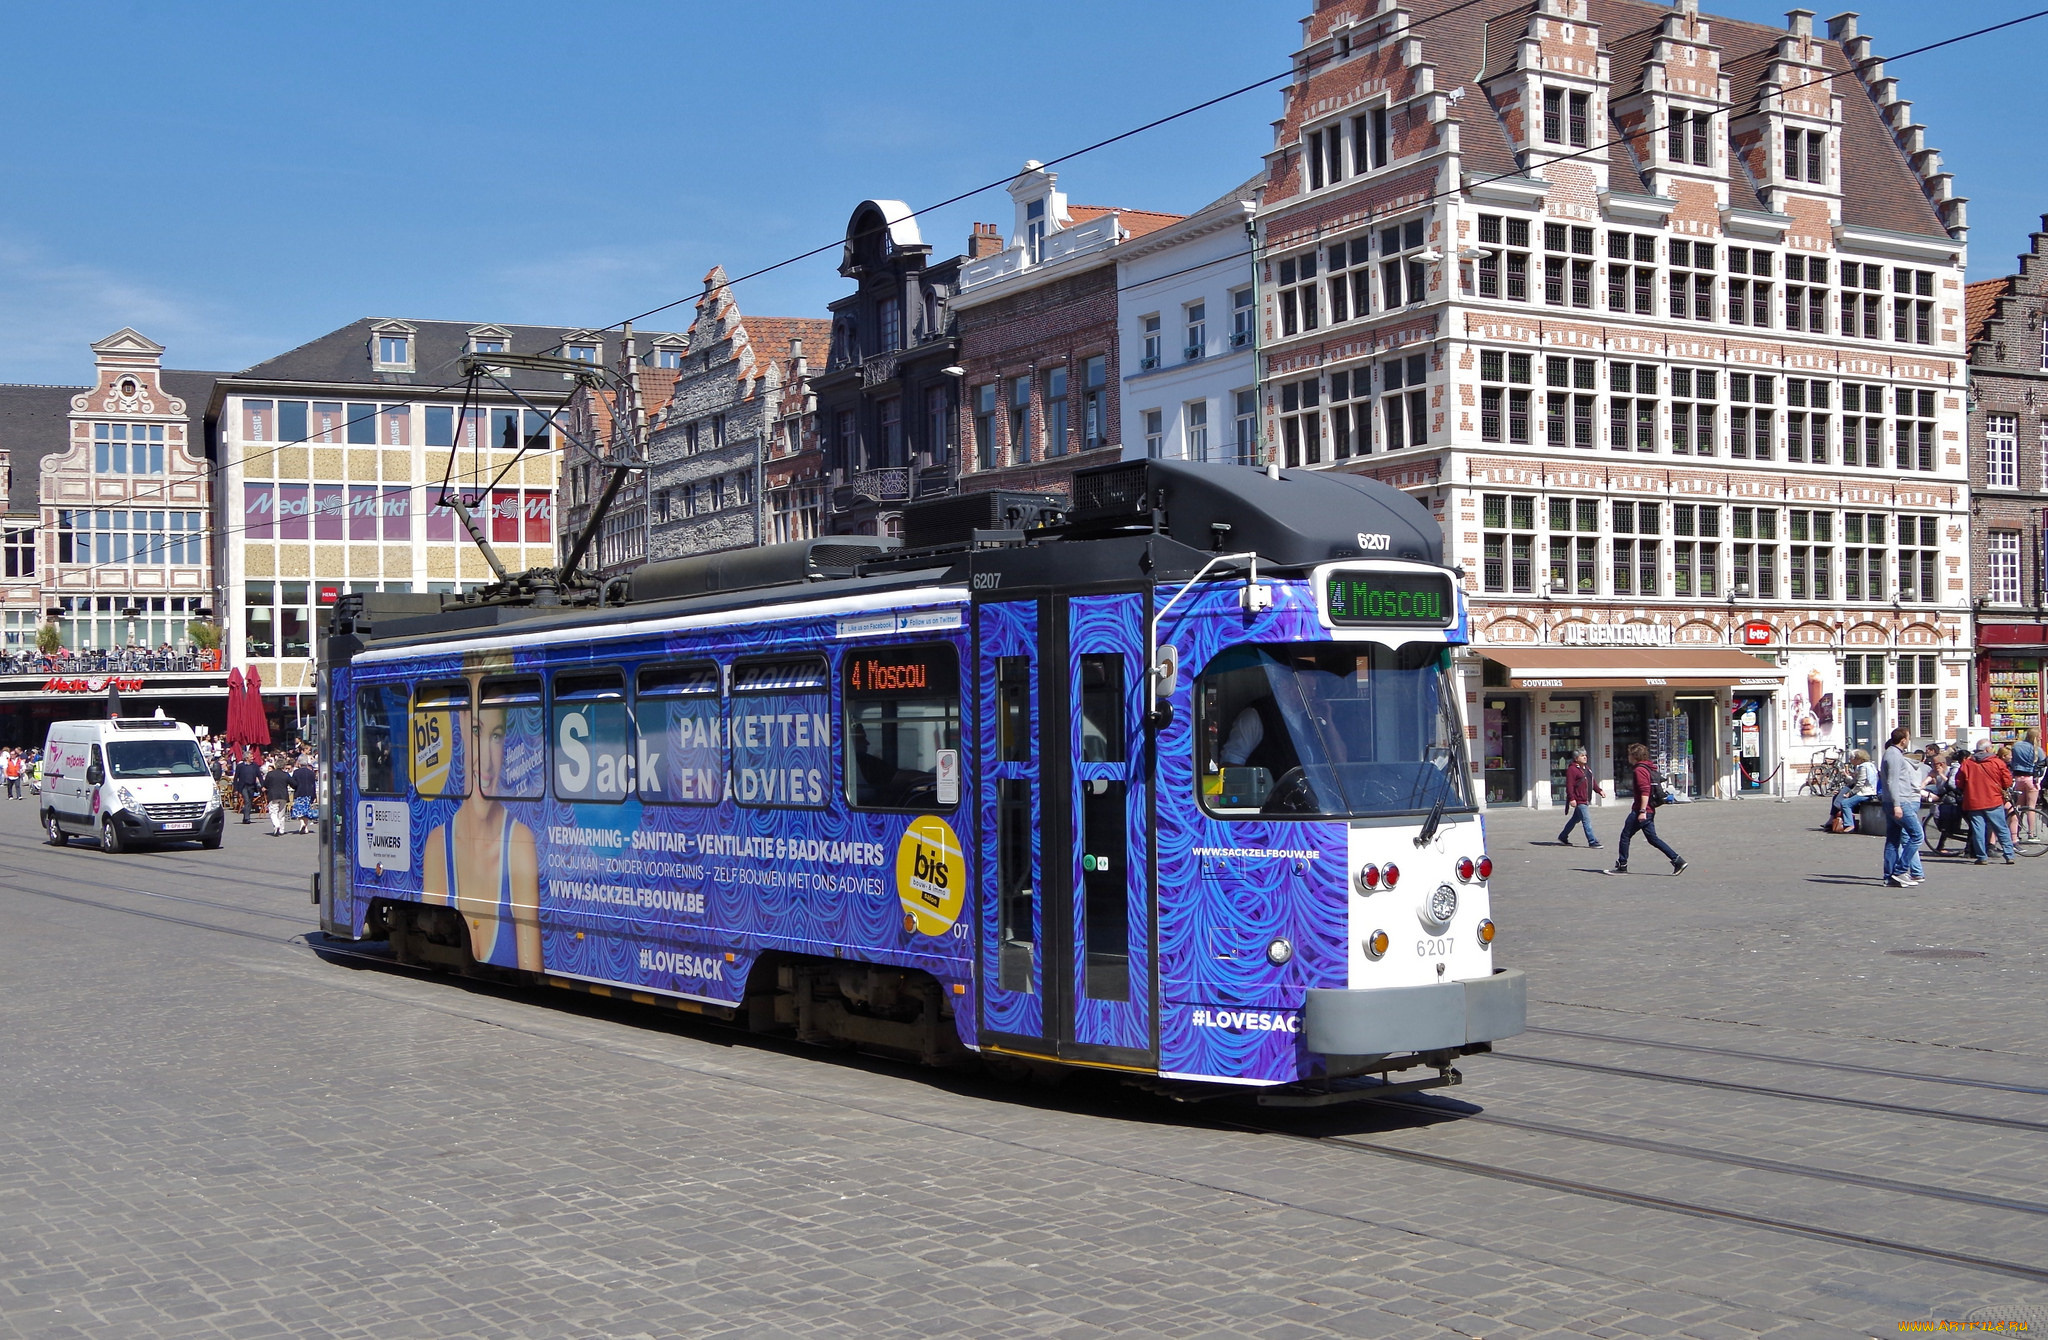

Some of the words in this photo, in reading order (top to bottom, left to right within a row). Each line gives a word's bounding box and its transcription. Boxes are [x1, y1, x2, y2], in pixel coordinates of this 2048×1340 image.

[1357, 533, 1391, 550] 6207
[973, 573, 1001, 590] 6207
[1353, 581, 1440, 618] Moscou
[910, 618, 925, 626] Follow
[940, 615, 958, 623] Twitter!
[1564, 624, 1587, 643] DE
[1588, 624, 1669, 643] GENTENAAR
[42, 677, 88, 692] Media
[101, 677, 144, 692] Markt
[852, 661, 861, 690] 4
[867, 660, 925, 690] Moscou
[415, 712, 440, 753] bis
[680, 714, 830, 750] PAKKETTEN
[558, 711, 662, 793] Sack
[682, 768, 712, 799] EN
[723, 769, 822, 802] ADVIES
[373, 835, 401, 849] JUNKERS
[548, 826, 622, 848] VERWARMING
[632, 831, 686, 853] SANITAIR
[697, 834, 774, 859] VENTILATIE
[775, 838, 787, 860] &
[788, 840, 885, 866] BADKAMERS
[1192, 847, 1320, 860] WWW.SACKZELFBOUW.BE
[549, 853, 566, 868] OOK
[581, 857, 598, 871] KAN
[606, 858, 642, 875] ZONDER
[644, 861, 704, 881] VOORKENNIS
[714, 866, 737, 883] ZELF
[739, 868, 785, 888] BOUWEN
[788, 872, 810, 889] MET
[812, 874, 836, 891] ONS
[839, 876, 885, 896] ADVIES!
[914, 843, 949, 889] bis
[549, 880, 705, 914] WWW.SACKZELFBOUW.BE
[953, 922, 969, 940] 07
[1416, 938, 1454, 957] 6207
[640, 948, 723, 982] #LOVESACK
[1192, 1010, 1306, 1034] #LOVESAC
